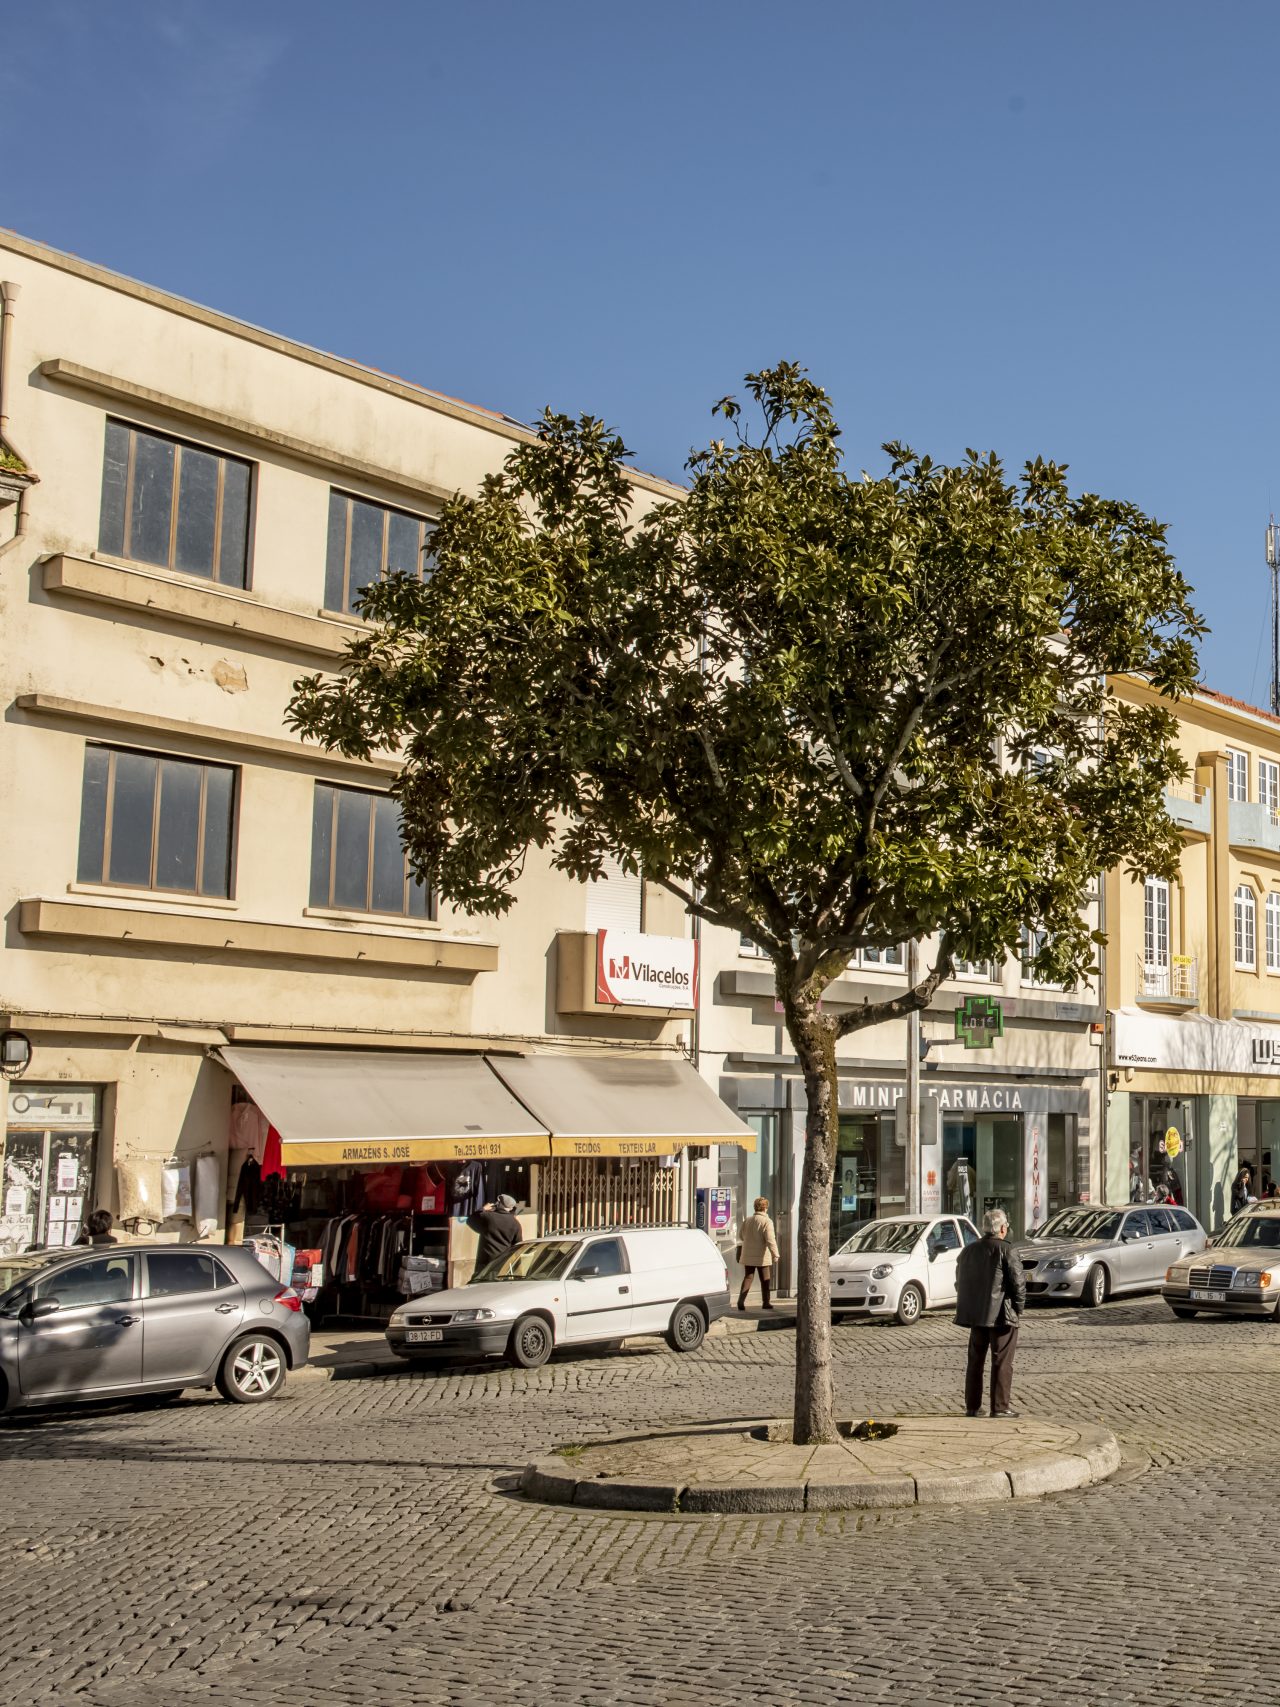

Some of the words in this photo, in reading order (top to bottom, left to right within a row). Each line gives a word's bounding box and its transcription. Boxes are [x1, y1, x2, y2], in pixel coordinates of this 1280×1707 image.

[631, 962, 689, 985] Vilacelos
[853, 1086, 904, 1107] MINH
[342, 1145, 382, 1160] ARMAZÉNS
[383, 1147, 391, 1159] S.
[392, 1145, 410, 1159] JOSÉ
[489, 1143, 502, 1155] 931
[574, 1143, 601, 1154] TECIDOS
[644, 1143, 657, 1153] LAR
